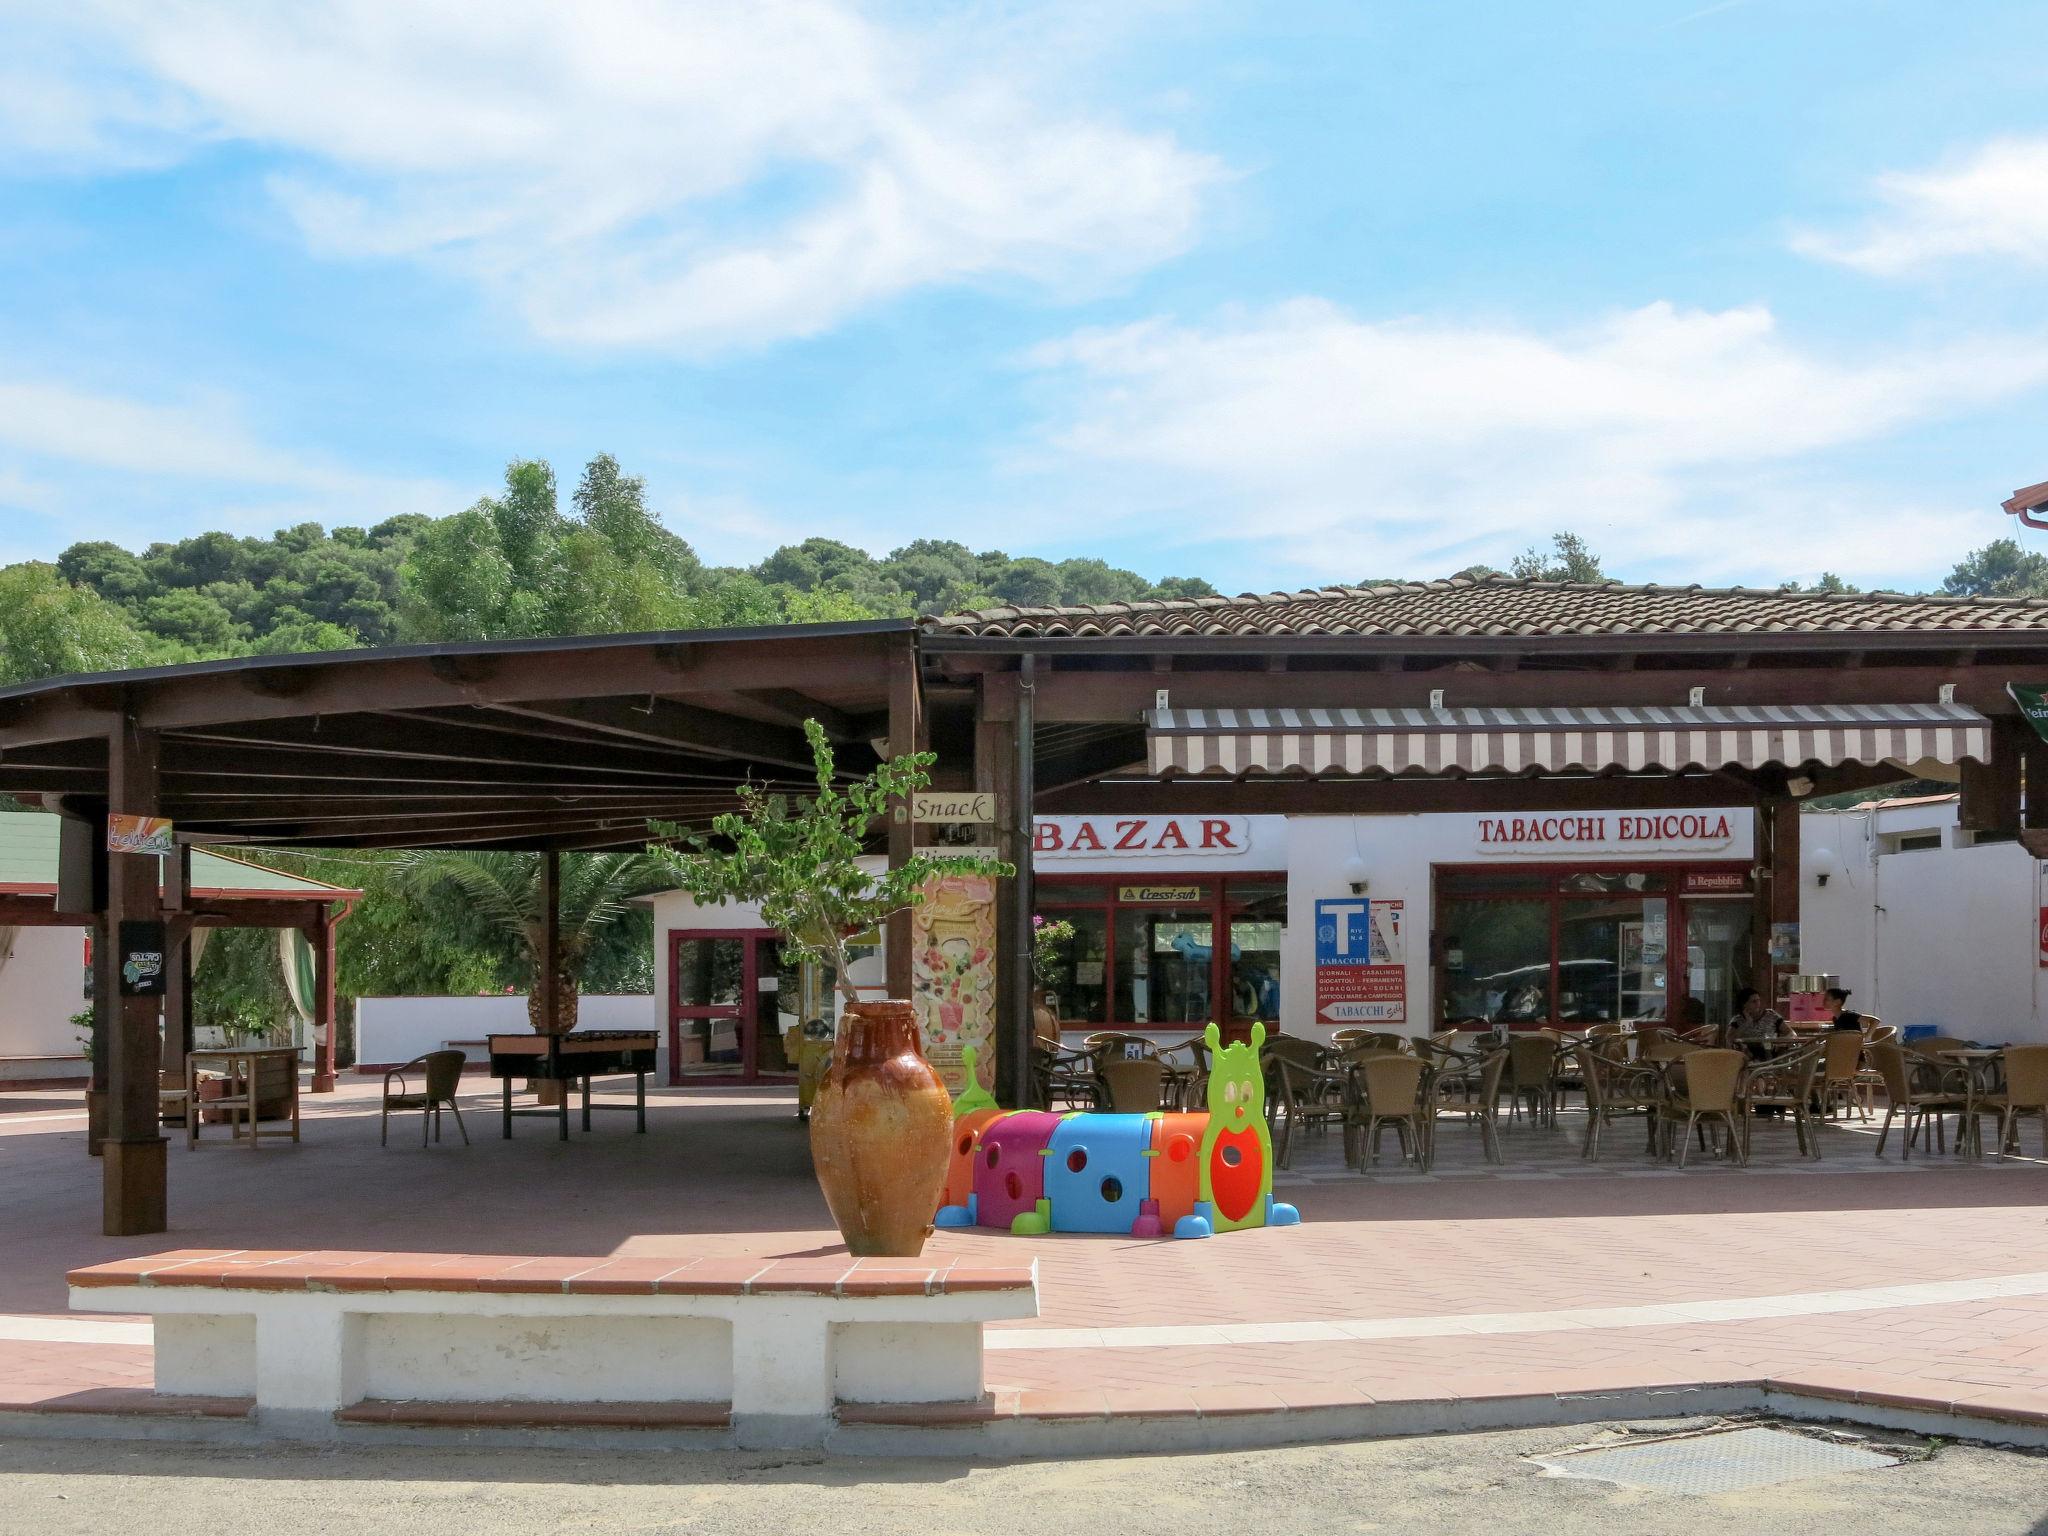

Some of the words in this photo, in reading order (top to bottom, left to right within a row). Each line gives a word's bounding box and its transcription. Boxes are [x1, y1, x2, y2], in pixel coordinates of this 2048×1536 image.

[913, 794, 994, 821] Snack
[1032, 819, 1238, 851] BAZAR
[1478, 817, 1605, 842] TABACCHI
[1618, 815, 1731, 840] EDICOLA
[1688, 876, 1696, 886] la
[1697, 876, 1741, 887] Repubblica
[1139, 887, 1197, 900] Cressi-sub
[1320, 904, 1365, 955] T
[1319, 957, 1366, 965] TABACCHI
[1334, 1005, 1385, 1017] TABACCHI
